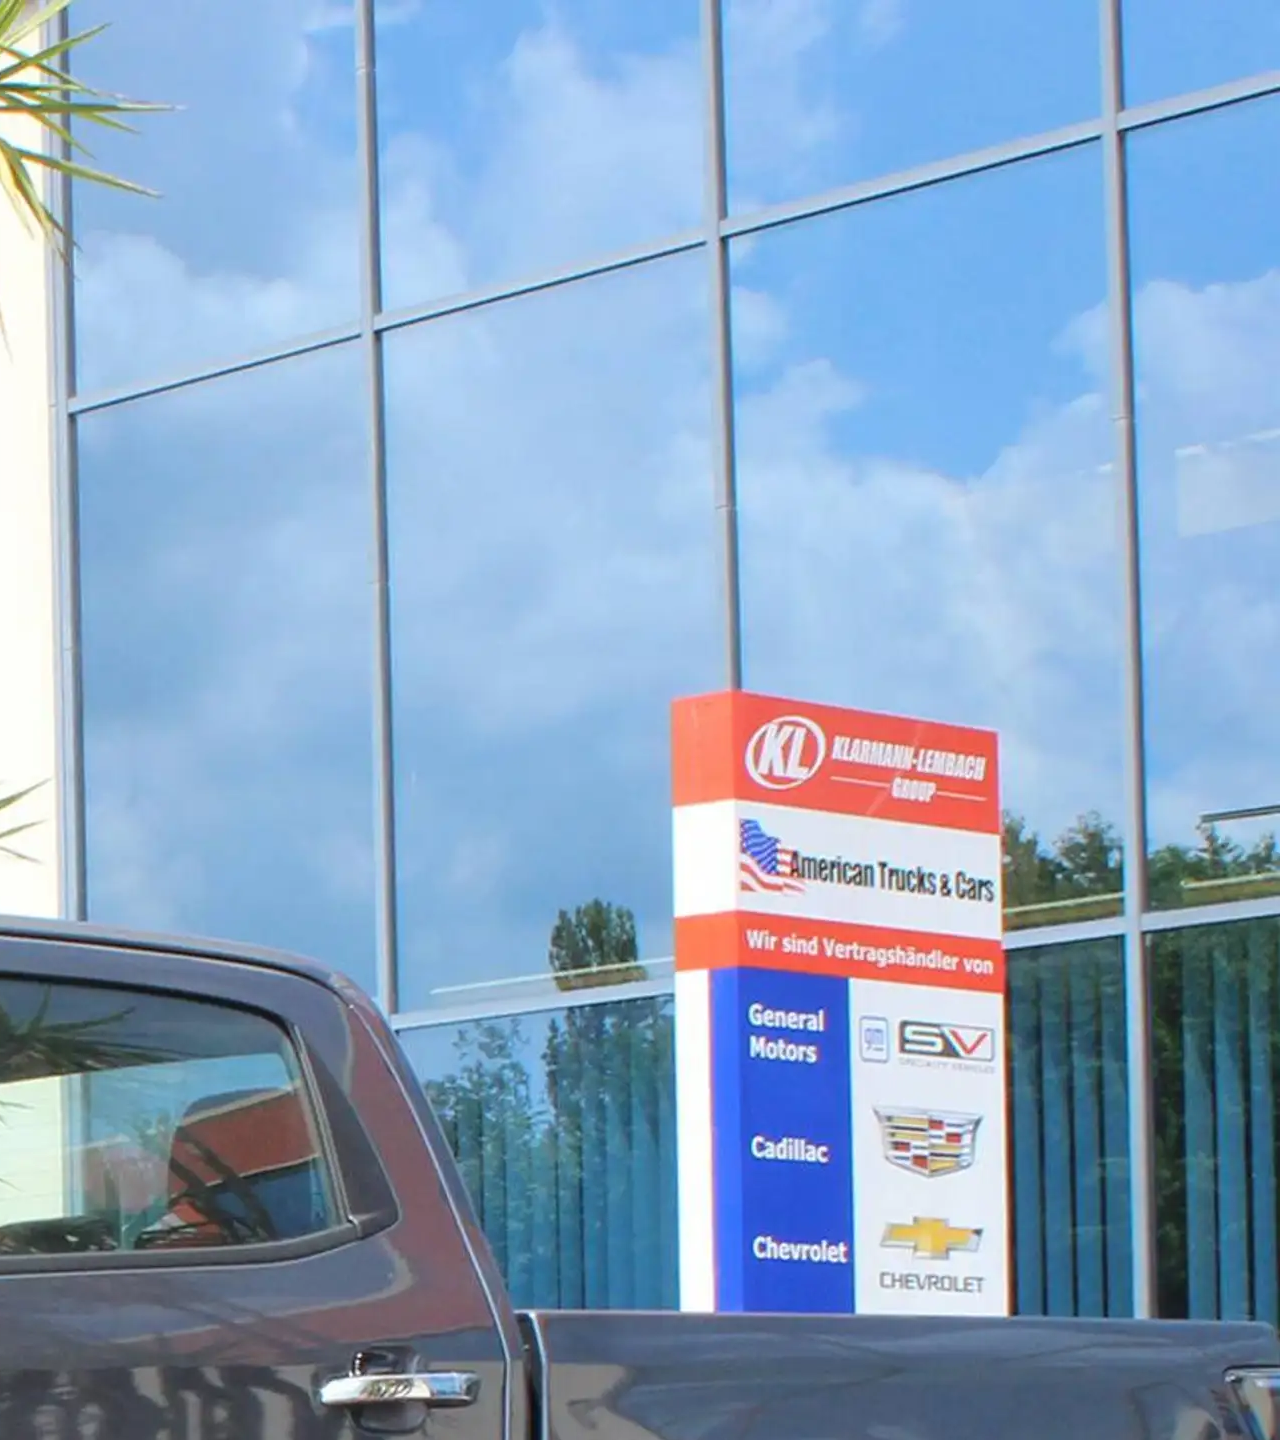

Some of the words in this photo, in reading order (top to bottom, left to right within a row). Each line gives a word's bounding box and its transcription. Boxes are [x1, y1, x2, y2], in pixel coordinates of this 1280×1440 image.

[758, 723, 810, 780] KL
[832, 735, 987, 781] KLARMANN-LEMBACH
[892, 777, 937, 802] GROUP
[791, 851, 875, 888] American
[877, 861, 936, 896] Trucks
[939, 873, 952, 897] &
[956, 871, 995, 902] Cars
[745, 929, 777, 950] Wir
[782, 933, 818, 955] sind
[822, 937, 959, 972] Vertragshändler
[963, 959, 994, 975] von
[748, 1003, 825, 1032] General
[749, 1035, 818, 1064] Motors
[751, 1135, 830, 1164] Cadillac
[752, 1235, 849, 1264] Chevrolet
[879, 1271, 985, 1294] CHEVROLET
